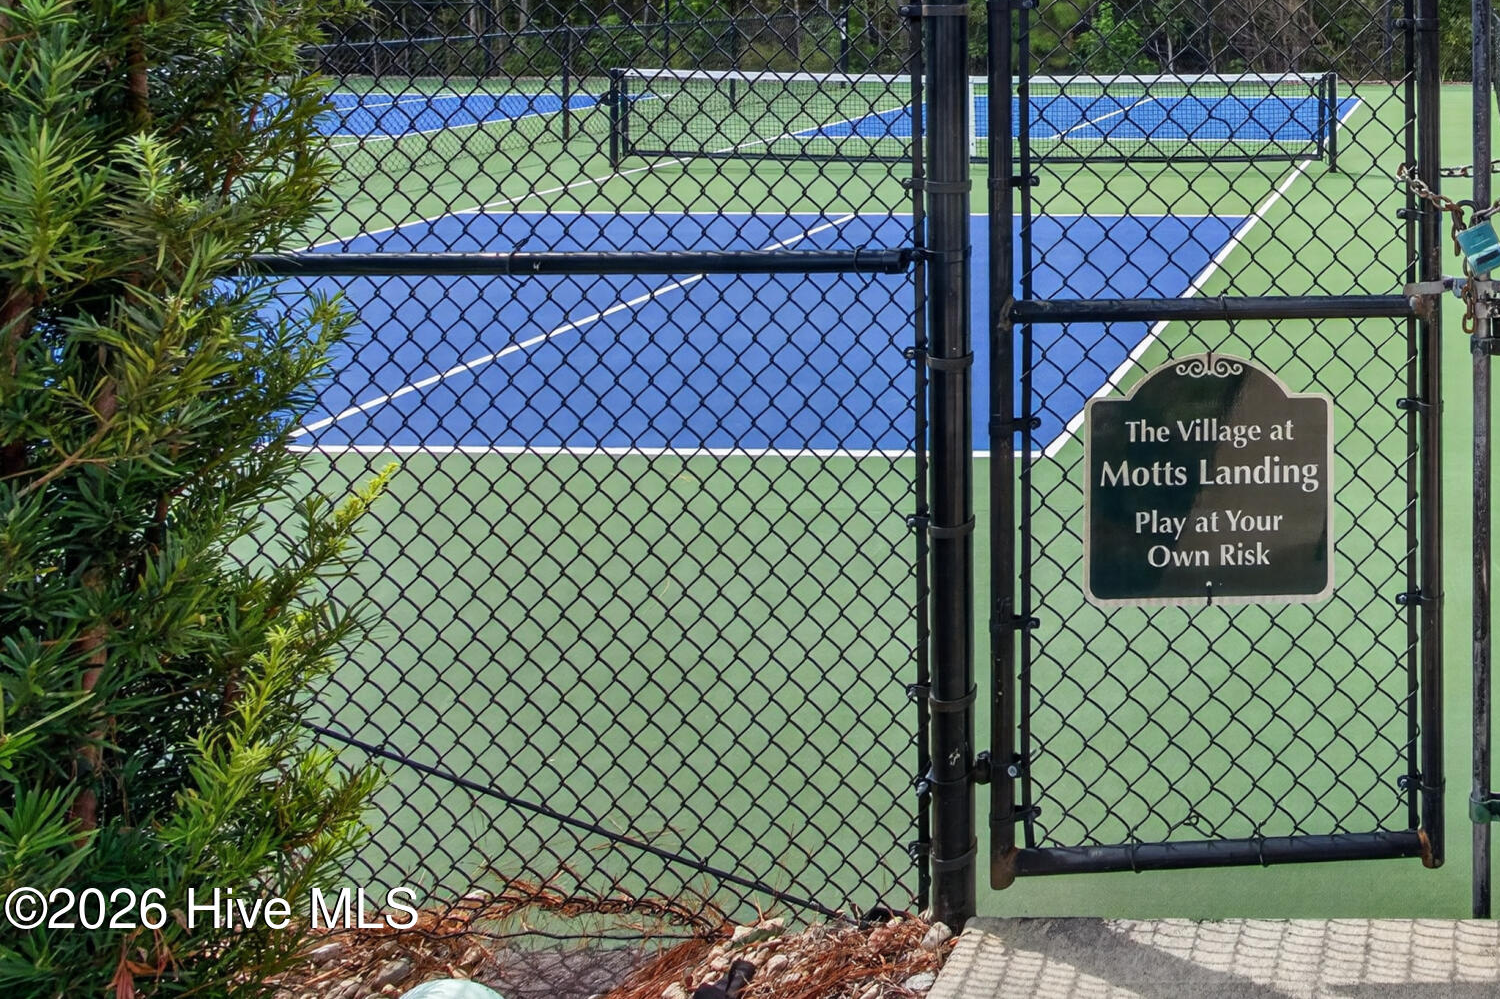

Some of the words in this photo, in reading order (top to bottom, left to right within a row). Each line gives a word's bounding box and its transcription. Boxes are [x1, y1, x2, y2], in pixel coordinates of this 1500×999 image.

[1125, 419, 1170, 443] The
[1176, 418, 1261, 448] Village
[1269, 419, 1294, 440] at
[1100, 460, 1188, 487] Motts
[1199, 456, 1319, 492] Landing
[1135, 510, 1187, 540] Play
[1195, 512, 1219, 533] at
[1225, 510, 1283, 532] Your
[1147, 545, 1210, 567] Own
[1220, 542, 1271, 566] Risk
